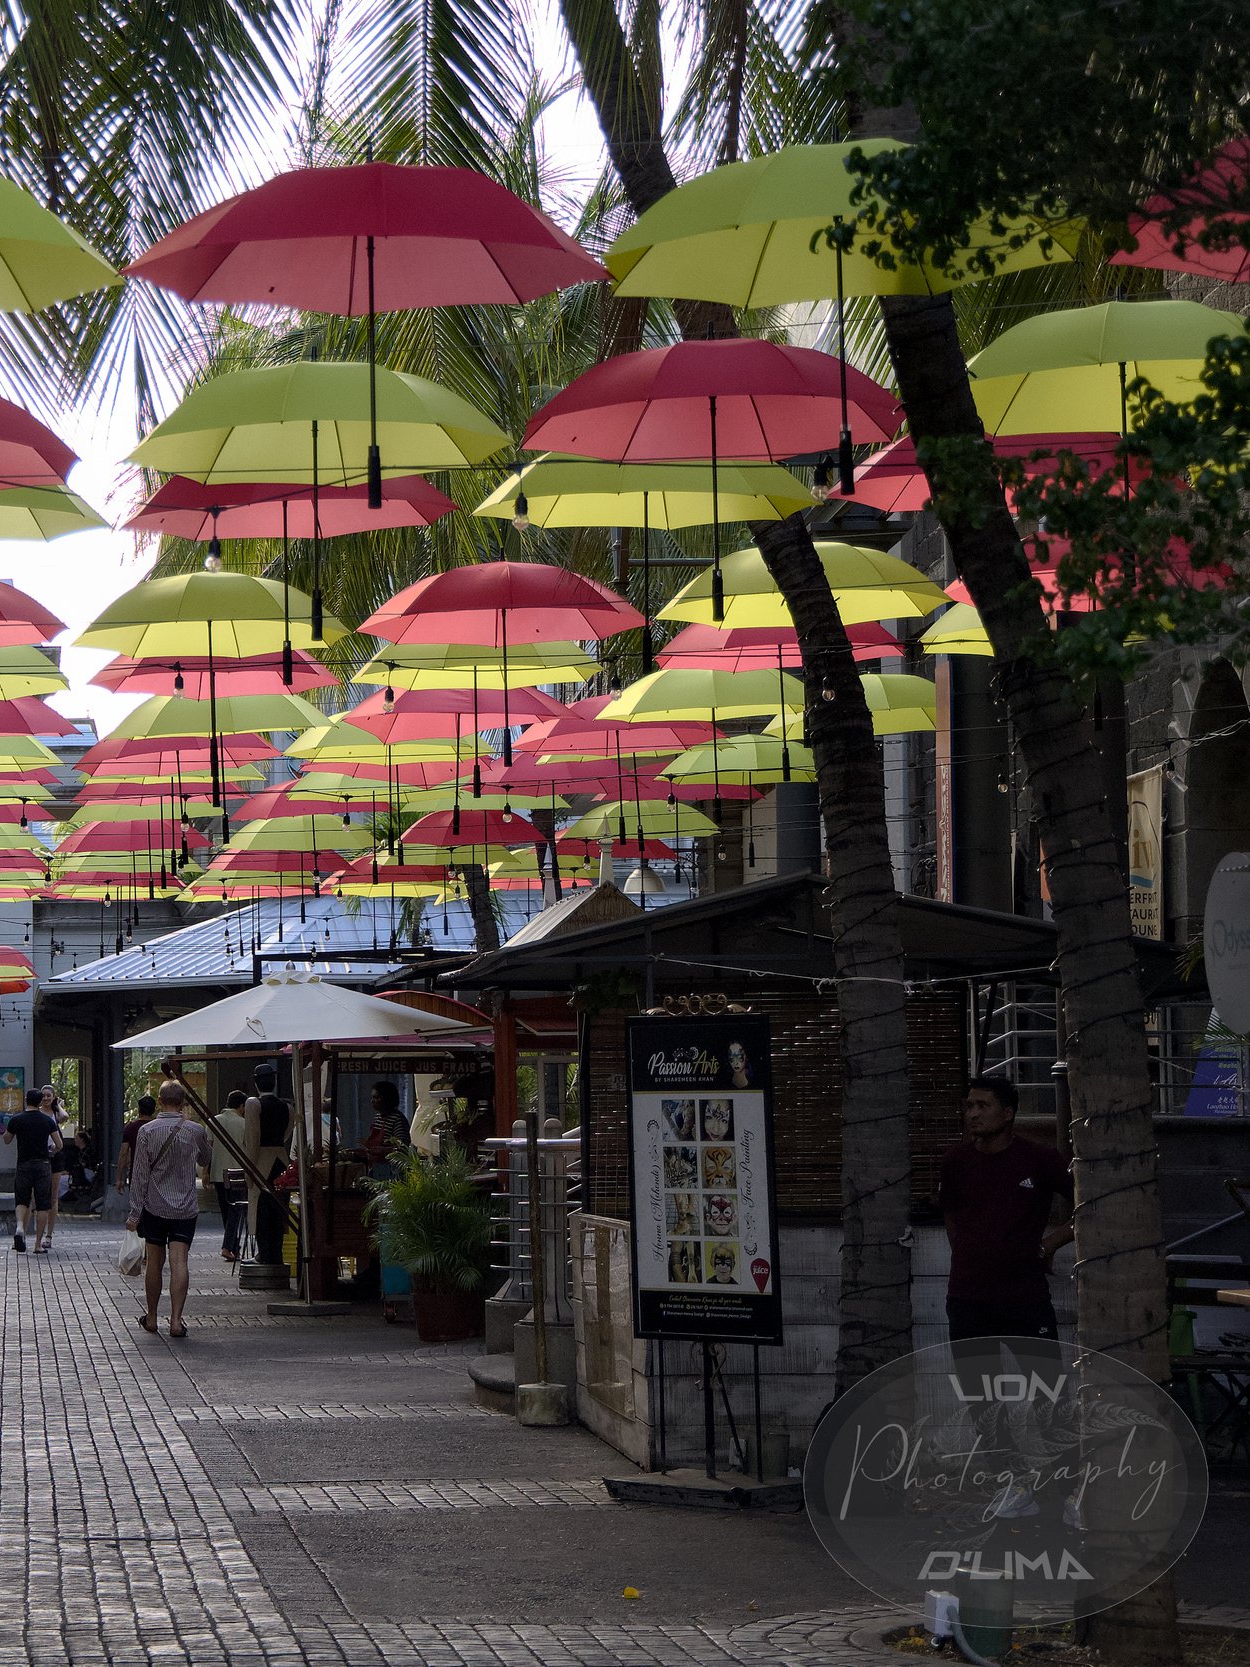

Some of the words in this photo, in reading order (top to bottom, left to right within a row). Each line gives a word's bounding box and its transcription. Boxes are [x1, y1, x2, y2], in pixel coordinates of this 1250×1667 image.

[374, 1060, 407, 1072] JUICE
[415, 1060, 437, 1072] JUS
[442, 1061, 477, 1073] FRAIS
[647, 1051, 693, 1075] Passion
[692, 1049, 720, 1074] Arts
[738, 1128, 754, 1178] Painting
[740, 1179, 754, 1208] Face
[652, 1225, 664, 1263] Henna
